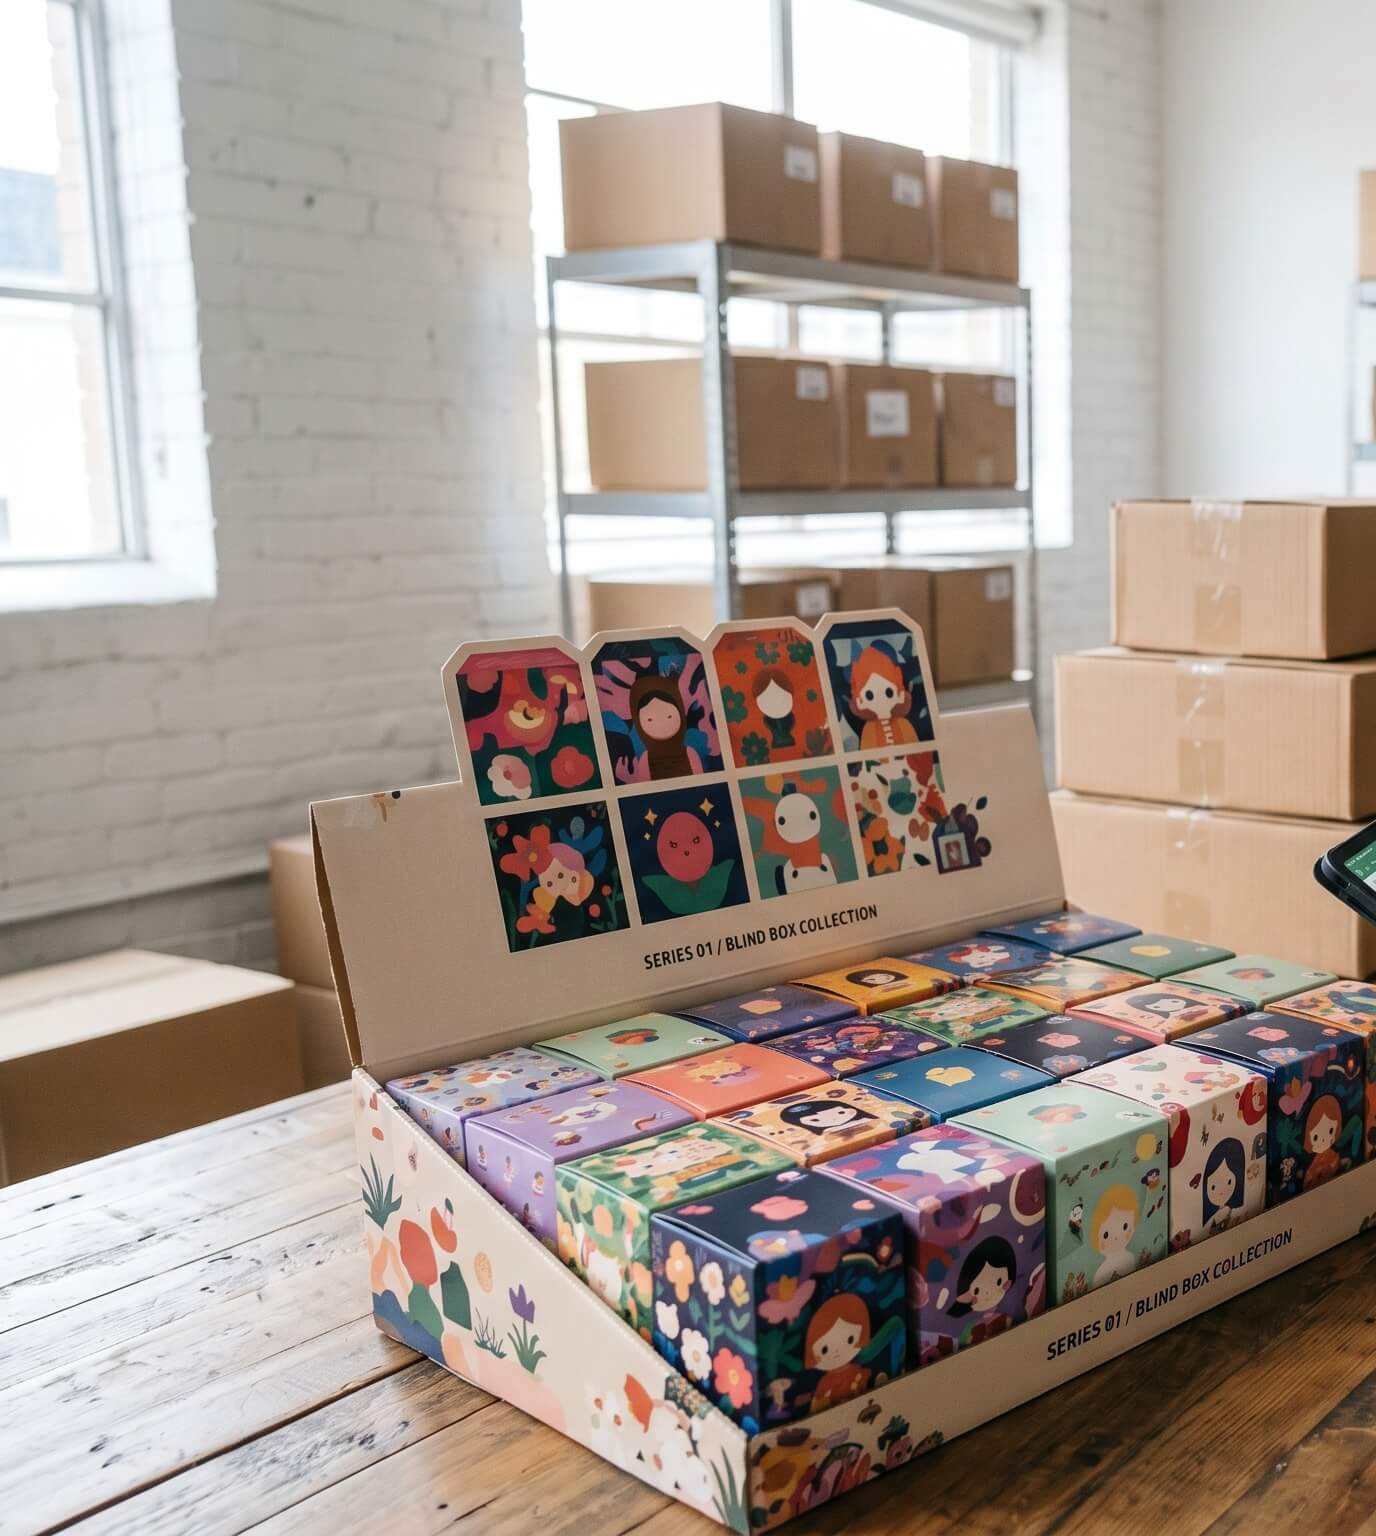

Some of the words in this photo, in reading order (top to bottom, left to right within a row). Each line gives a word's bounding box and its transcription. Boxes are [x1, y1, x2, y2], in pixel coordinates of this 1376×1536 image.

[644, 945, 694, 969] SERIES
[697, 942, 713, 958] 01
[717, 939, 722, 955] /
[725, 930, 766, 951] BLIND
[769, 923, 797, 941] BOX
[799, 904, 878, 934] COLLECTION
[1047, 1320, 1101, 1361] SERIES
[1104, 1310, 1121, 1332] 01
[1126, 1303, 1133, 1326] /
[1135, 1284, 1178, 1318] BLIND
[1182, 1268, 1210, 1295] BOX
[1213, 1228, 1293, 1279] COLLECTION
